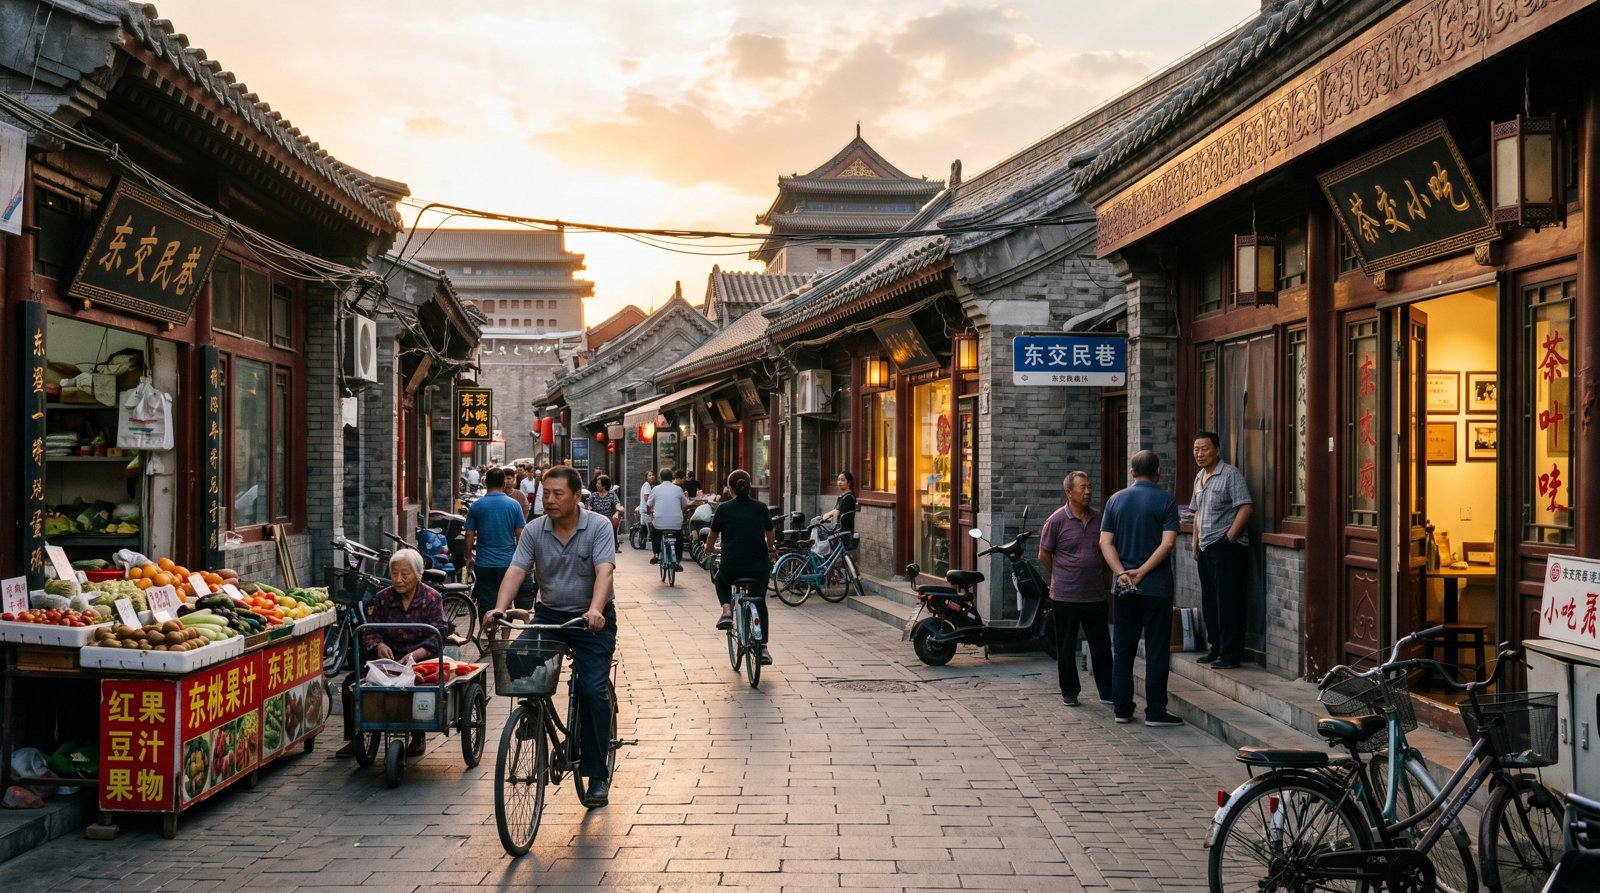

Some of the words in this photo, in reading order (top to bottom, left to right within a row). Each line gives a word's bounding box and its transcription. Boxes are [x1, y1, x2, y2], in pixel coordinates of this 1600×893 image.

[98, 214, 202, 296] 东交民巷
[1024, 344, 1115, 366] 东交民巷
[108, 690, 166, 724] 红果
[188, 660, 257, 729] 东桃果汁
[107, 730, 165, 763] 豆汁
[106, 768, 164, 802] 果物
